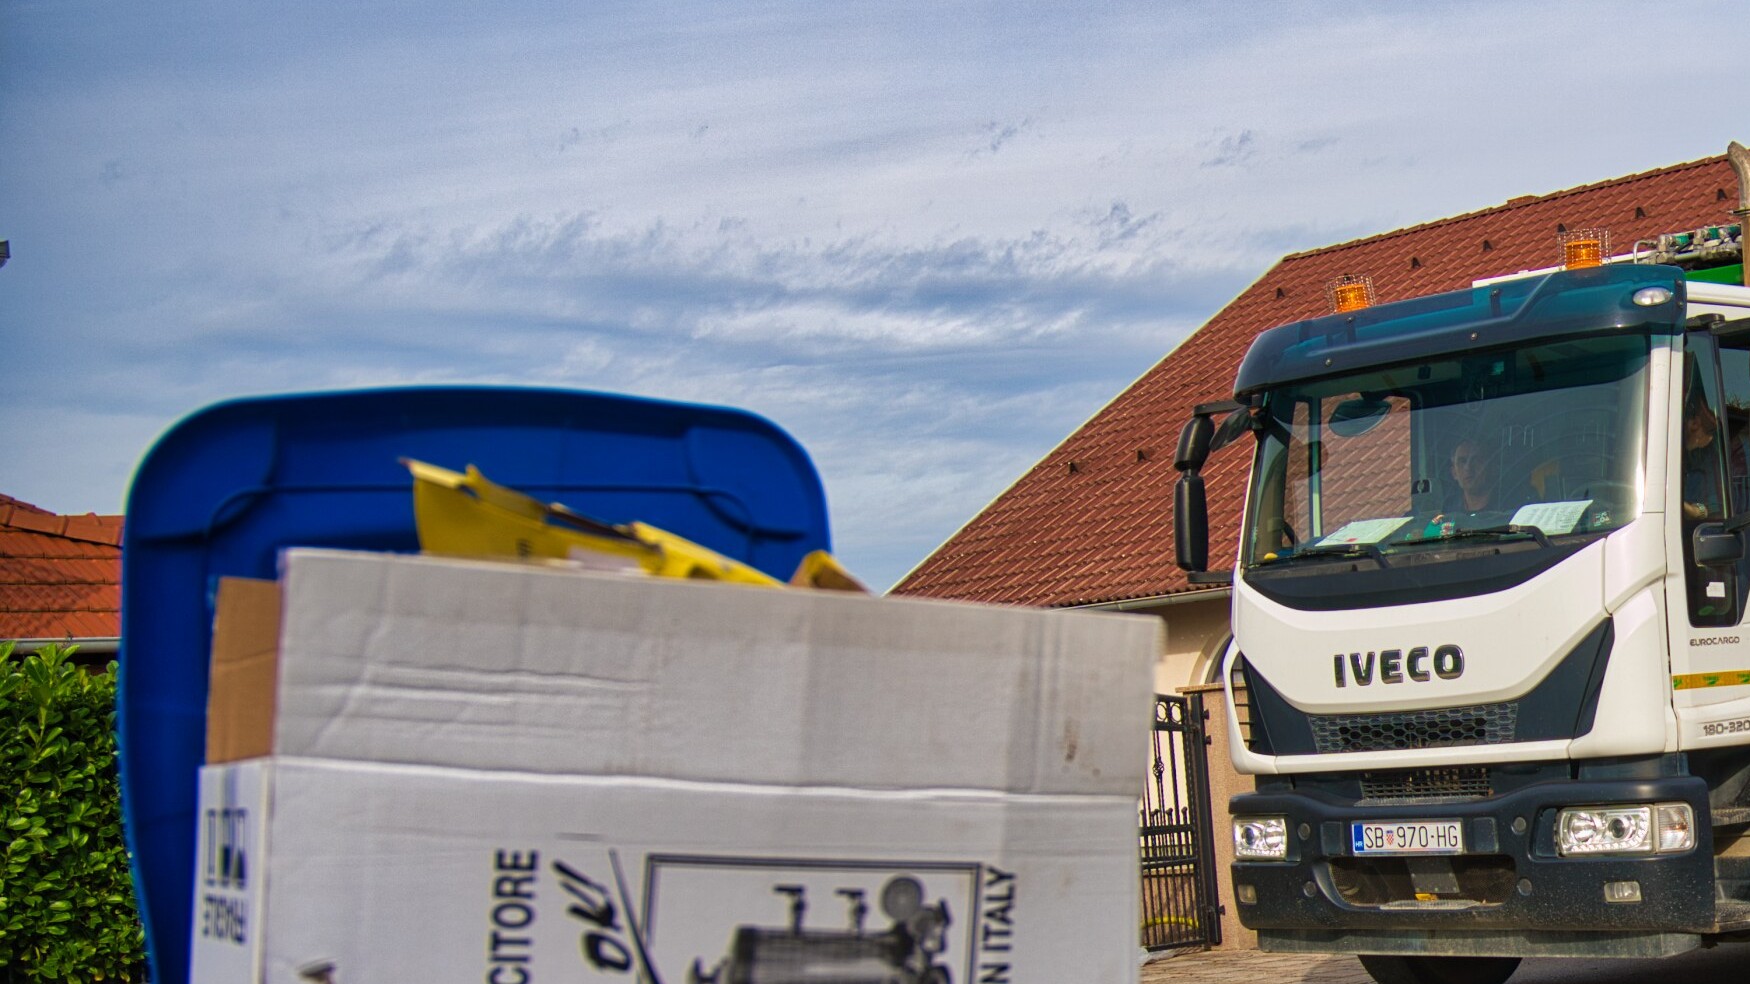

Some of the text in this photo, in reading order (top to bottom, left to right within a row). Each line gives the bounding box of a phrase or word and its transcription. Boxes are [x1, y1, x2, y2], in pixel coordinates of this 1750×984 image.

[1689, 636, 1741, 647] EUROCARGO
[1334, 644, 1465, 688] IVECO
[1364, 827, 1384, 848] SB
[982, 866, 1017, 952] ITALY
